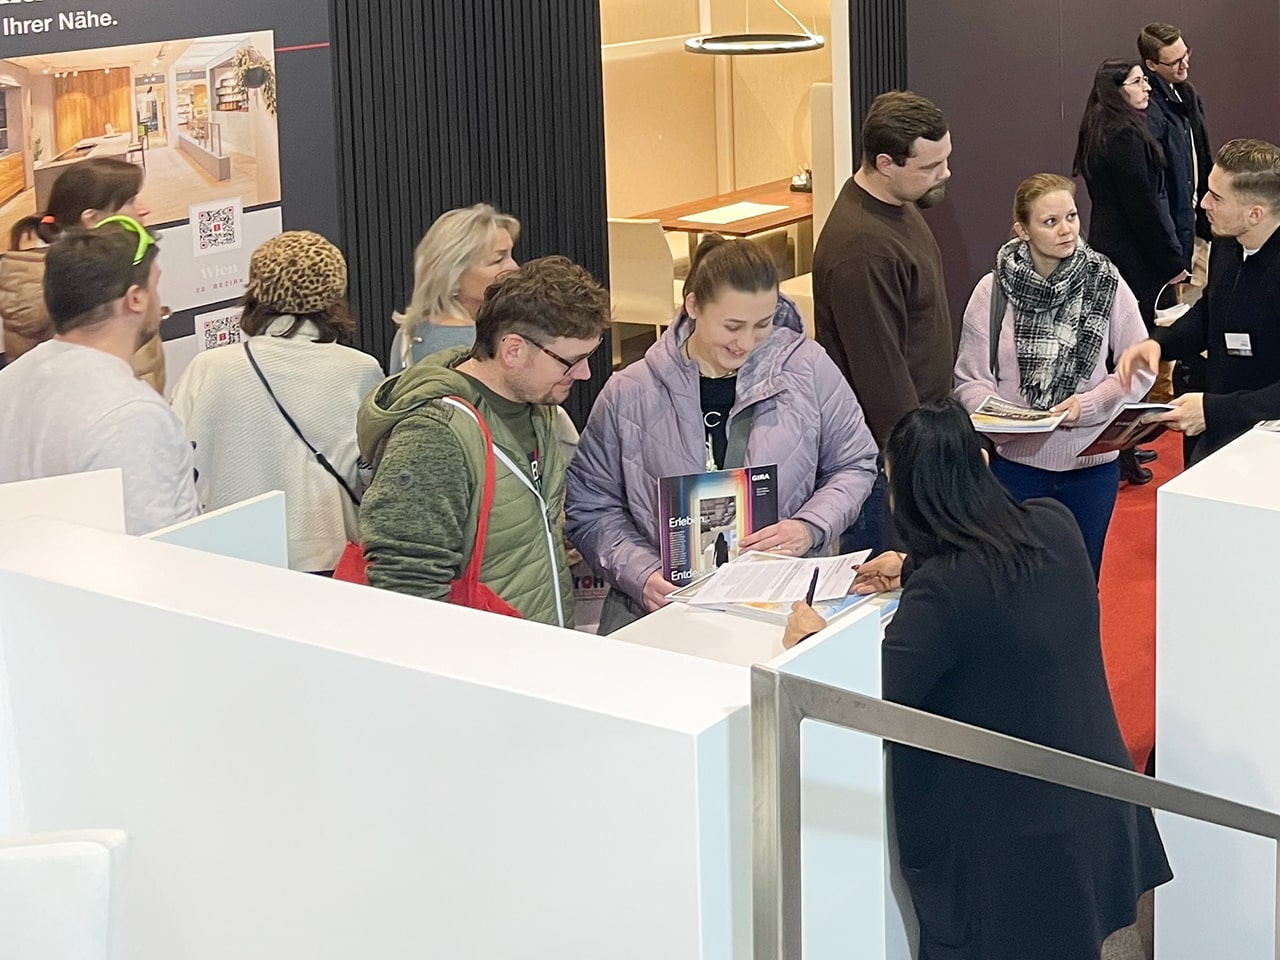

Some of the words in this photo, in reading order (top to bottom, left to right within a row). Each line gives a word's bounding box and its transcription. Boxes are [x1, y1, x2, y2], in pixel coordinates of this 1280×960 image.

[3, 17, 53, 36] Ihrer
[58, 10, 118, 31] Nähe.
[752, 473, 770, 481] GIRA
